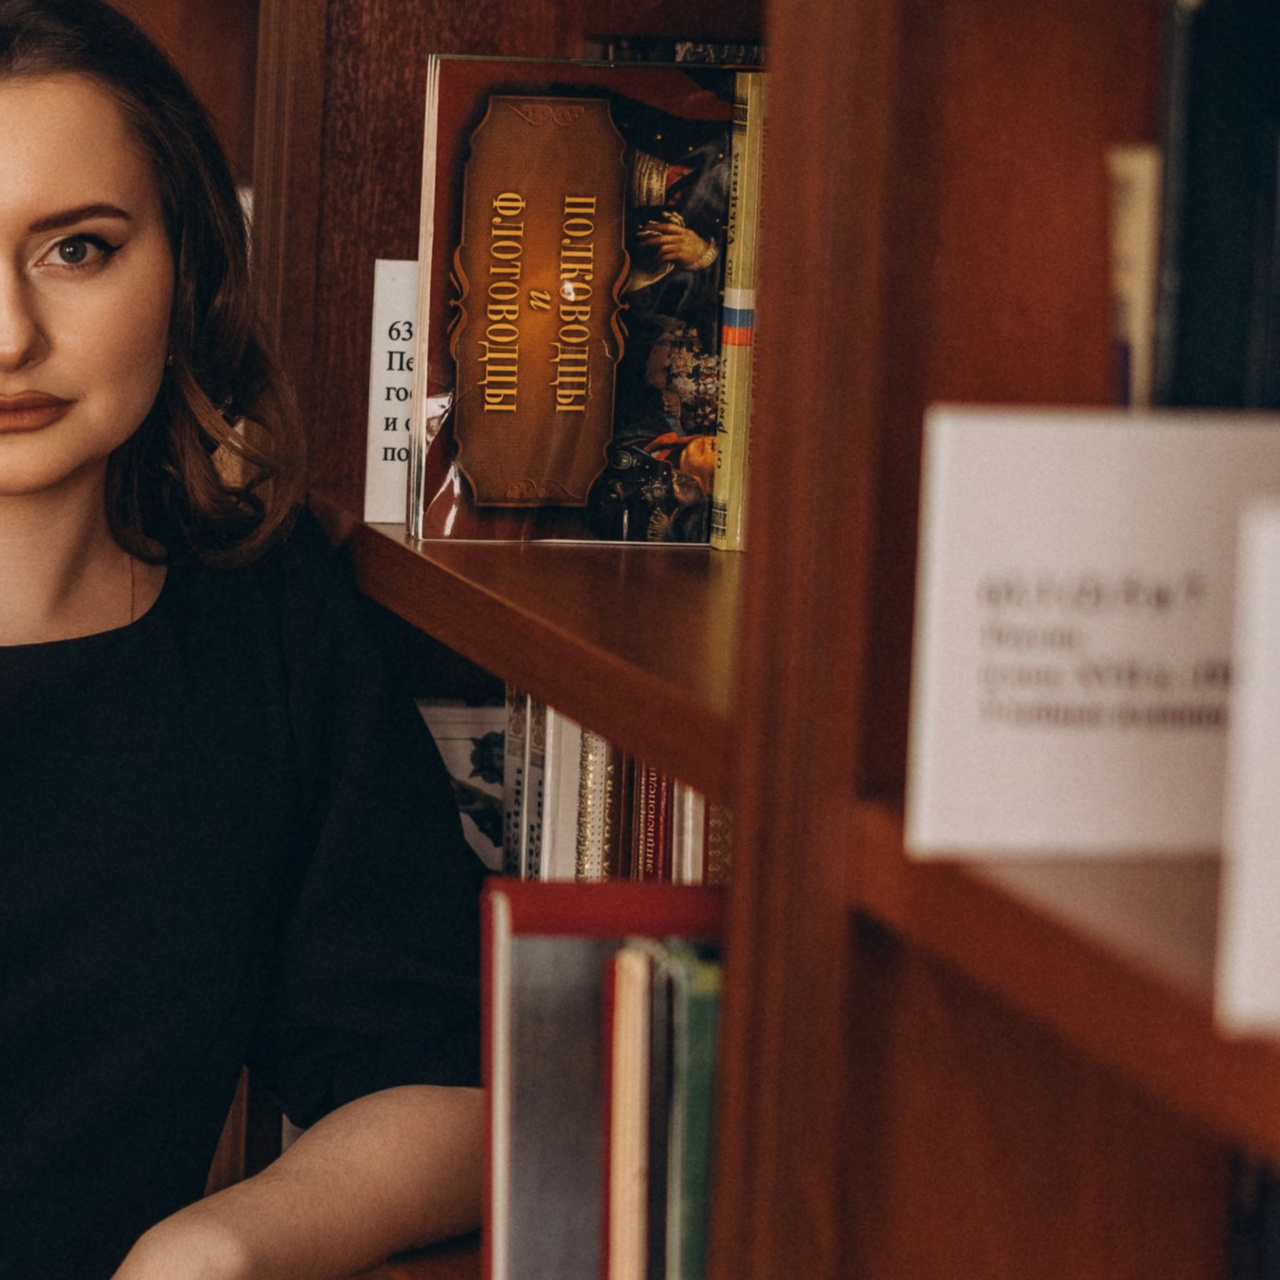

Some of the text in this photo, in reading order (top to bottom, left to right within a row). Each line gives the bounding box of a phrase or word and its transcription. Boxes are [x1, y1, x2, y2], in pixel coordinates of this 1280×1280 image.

[476, 191, 527, 413] ФЛОТОВОДЦЫ
[548, 195, 597, 413] ПОЛКОВОДЦЫ
[388, 320, 414, 342] 63
[386, 351, 414, 372] Пе
[383, 417, 398, 432] и
[382, 446, 410, 462] по
